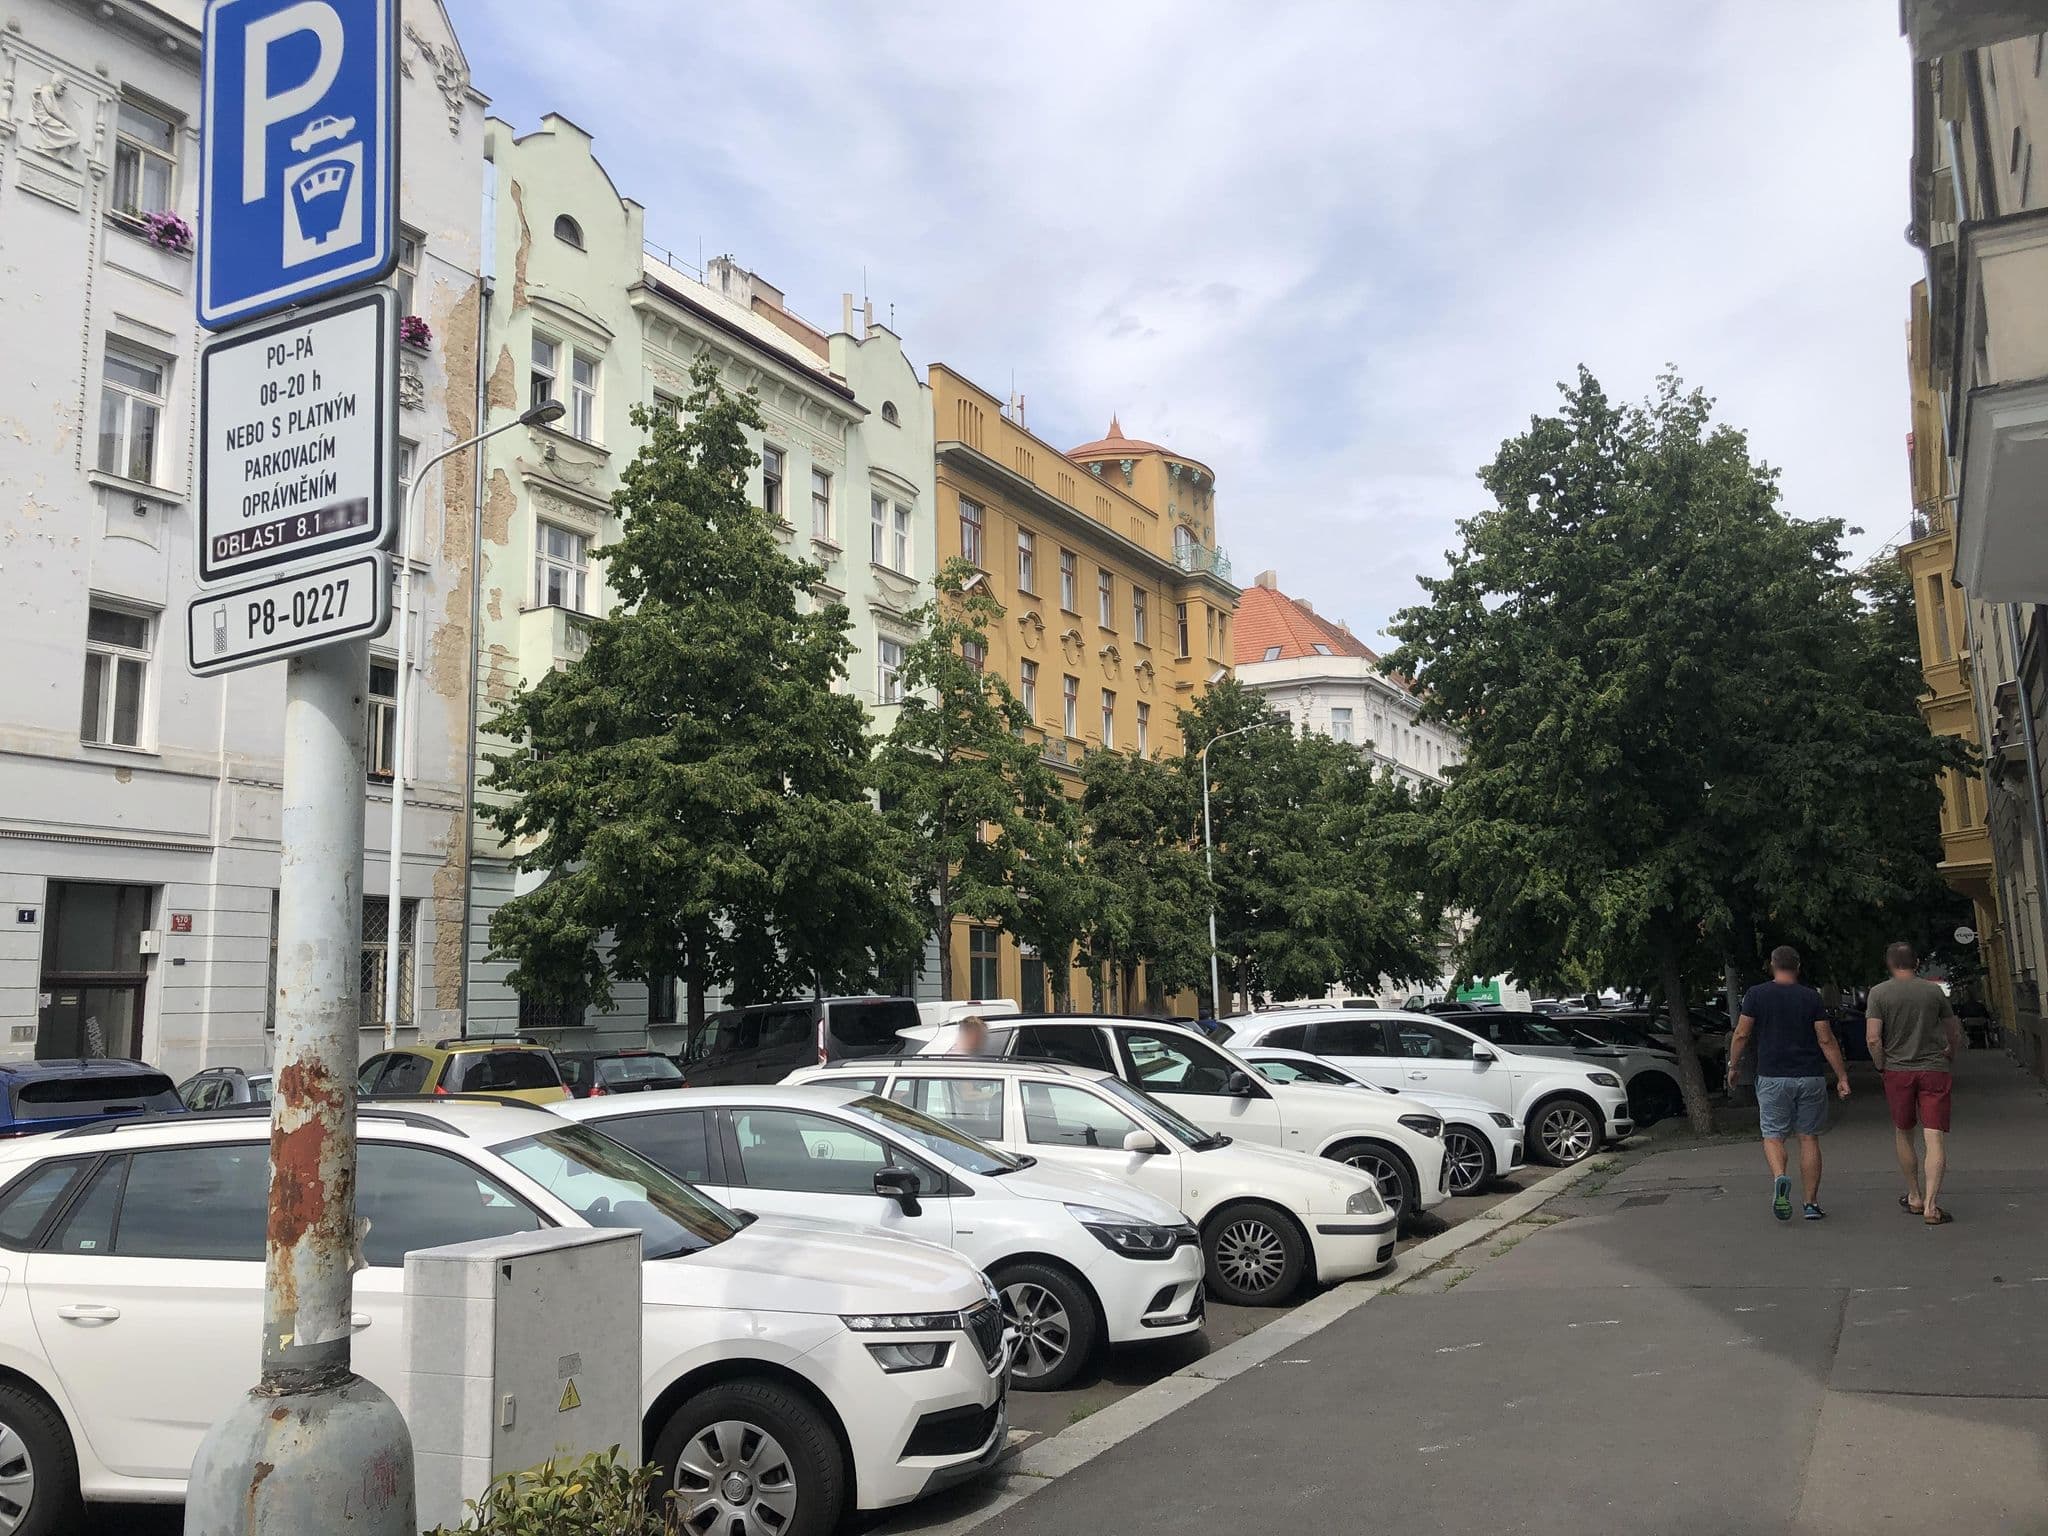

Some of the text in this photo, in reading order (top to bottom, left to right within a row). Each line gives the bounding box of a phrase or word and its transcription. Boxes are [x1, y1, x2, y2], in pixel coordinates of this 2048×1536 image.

[243, 1, 344, 204] P
[267, 330, 313, 369] PO-PÁ
[260, 370, 320, 406] 08-20 h
[226, 391, 356, 451] NEBO S PLATNÝM
[244, 433, 336, 482] PARKOVACÍM
[242, 470, 337, 518] OPRÁVNĚNÍM
[216, 522, 286, 558] OBLAST
[248, 579, 350, 639] P8-0227
